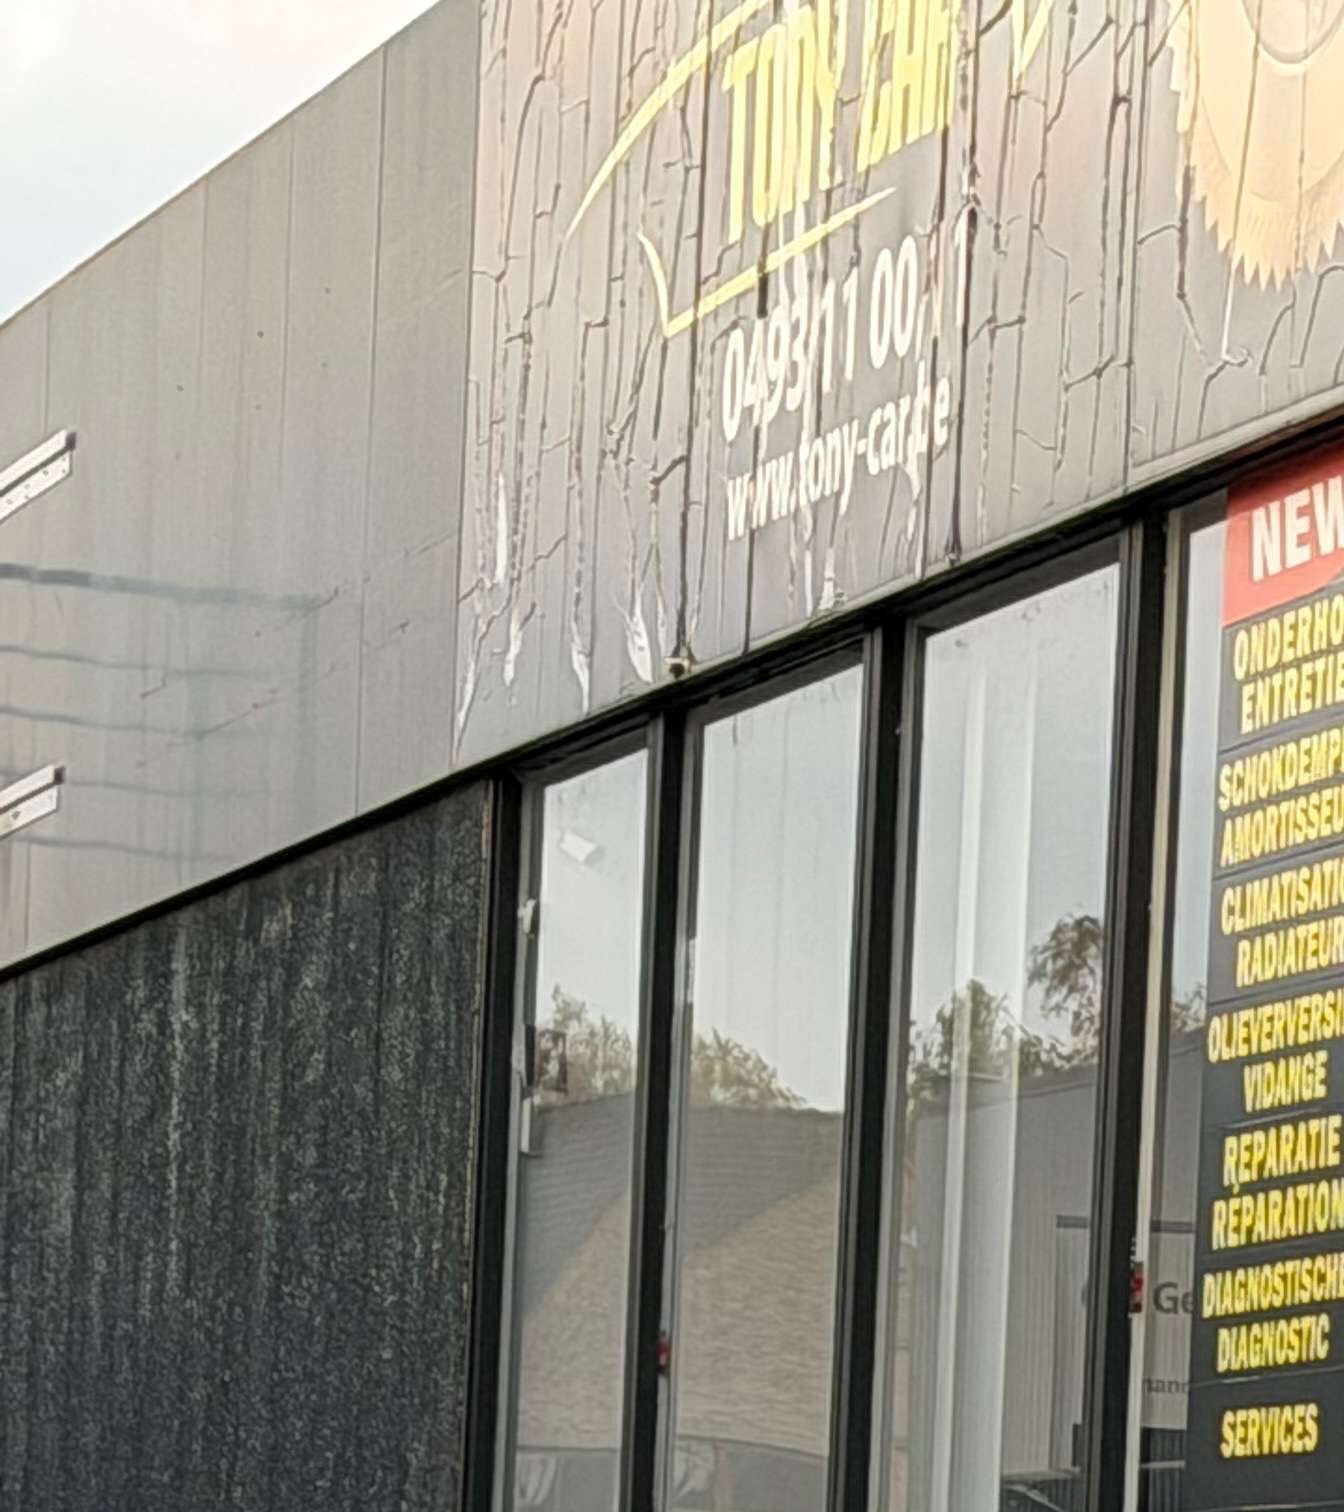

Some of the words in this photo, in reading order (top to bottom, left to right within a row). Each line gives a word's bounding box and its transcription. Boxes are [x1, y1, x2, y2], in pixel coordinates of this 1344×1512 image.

[1242, 1051, 1328, 1112] VIDANGE
[1223, 1113, 1343, 1186] REPARATIE
[1216, 1312, 1330, 1373] DIAGNOSTIC
[1220, 1403, 1319, 1458] SERVICES
